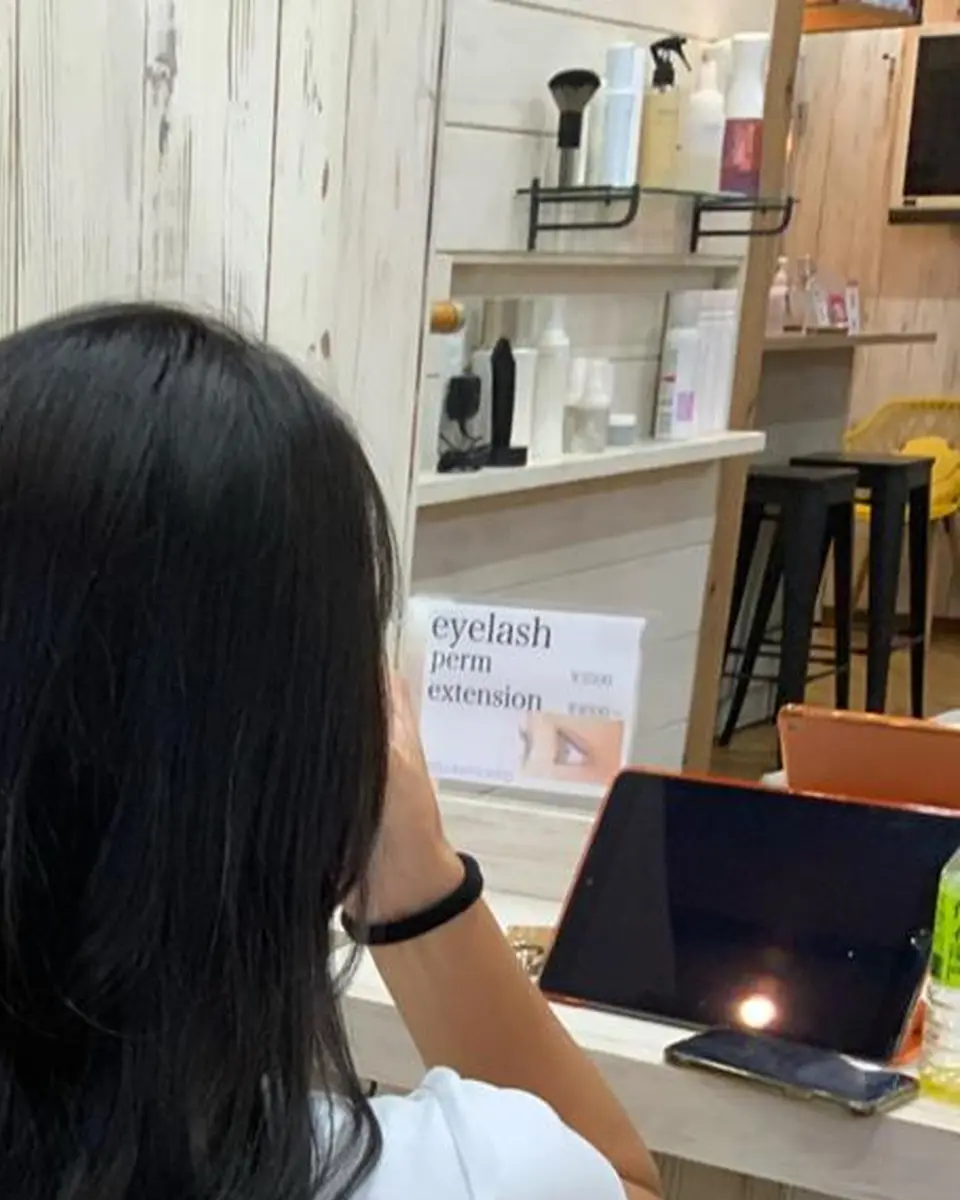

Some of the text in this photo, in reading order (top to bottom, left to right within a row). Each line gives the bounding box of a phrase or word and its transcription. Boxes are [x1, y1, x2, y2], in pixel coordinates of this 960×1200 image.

[432, 612, 552, 649] eyelash
[430, 650, 492, 673] perm
[428, 683, 542, 711] extension
